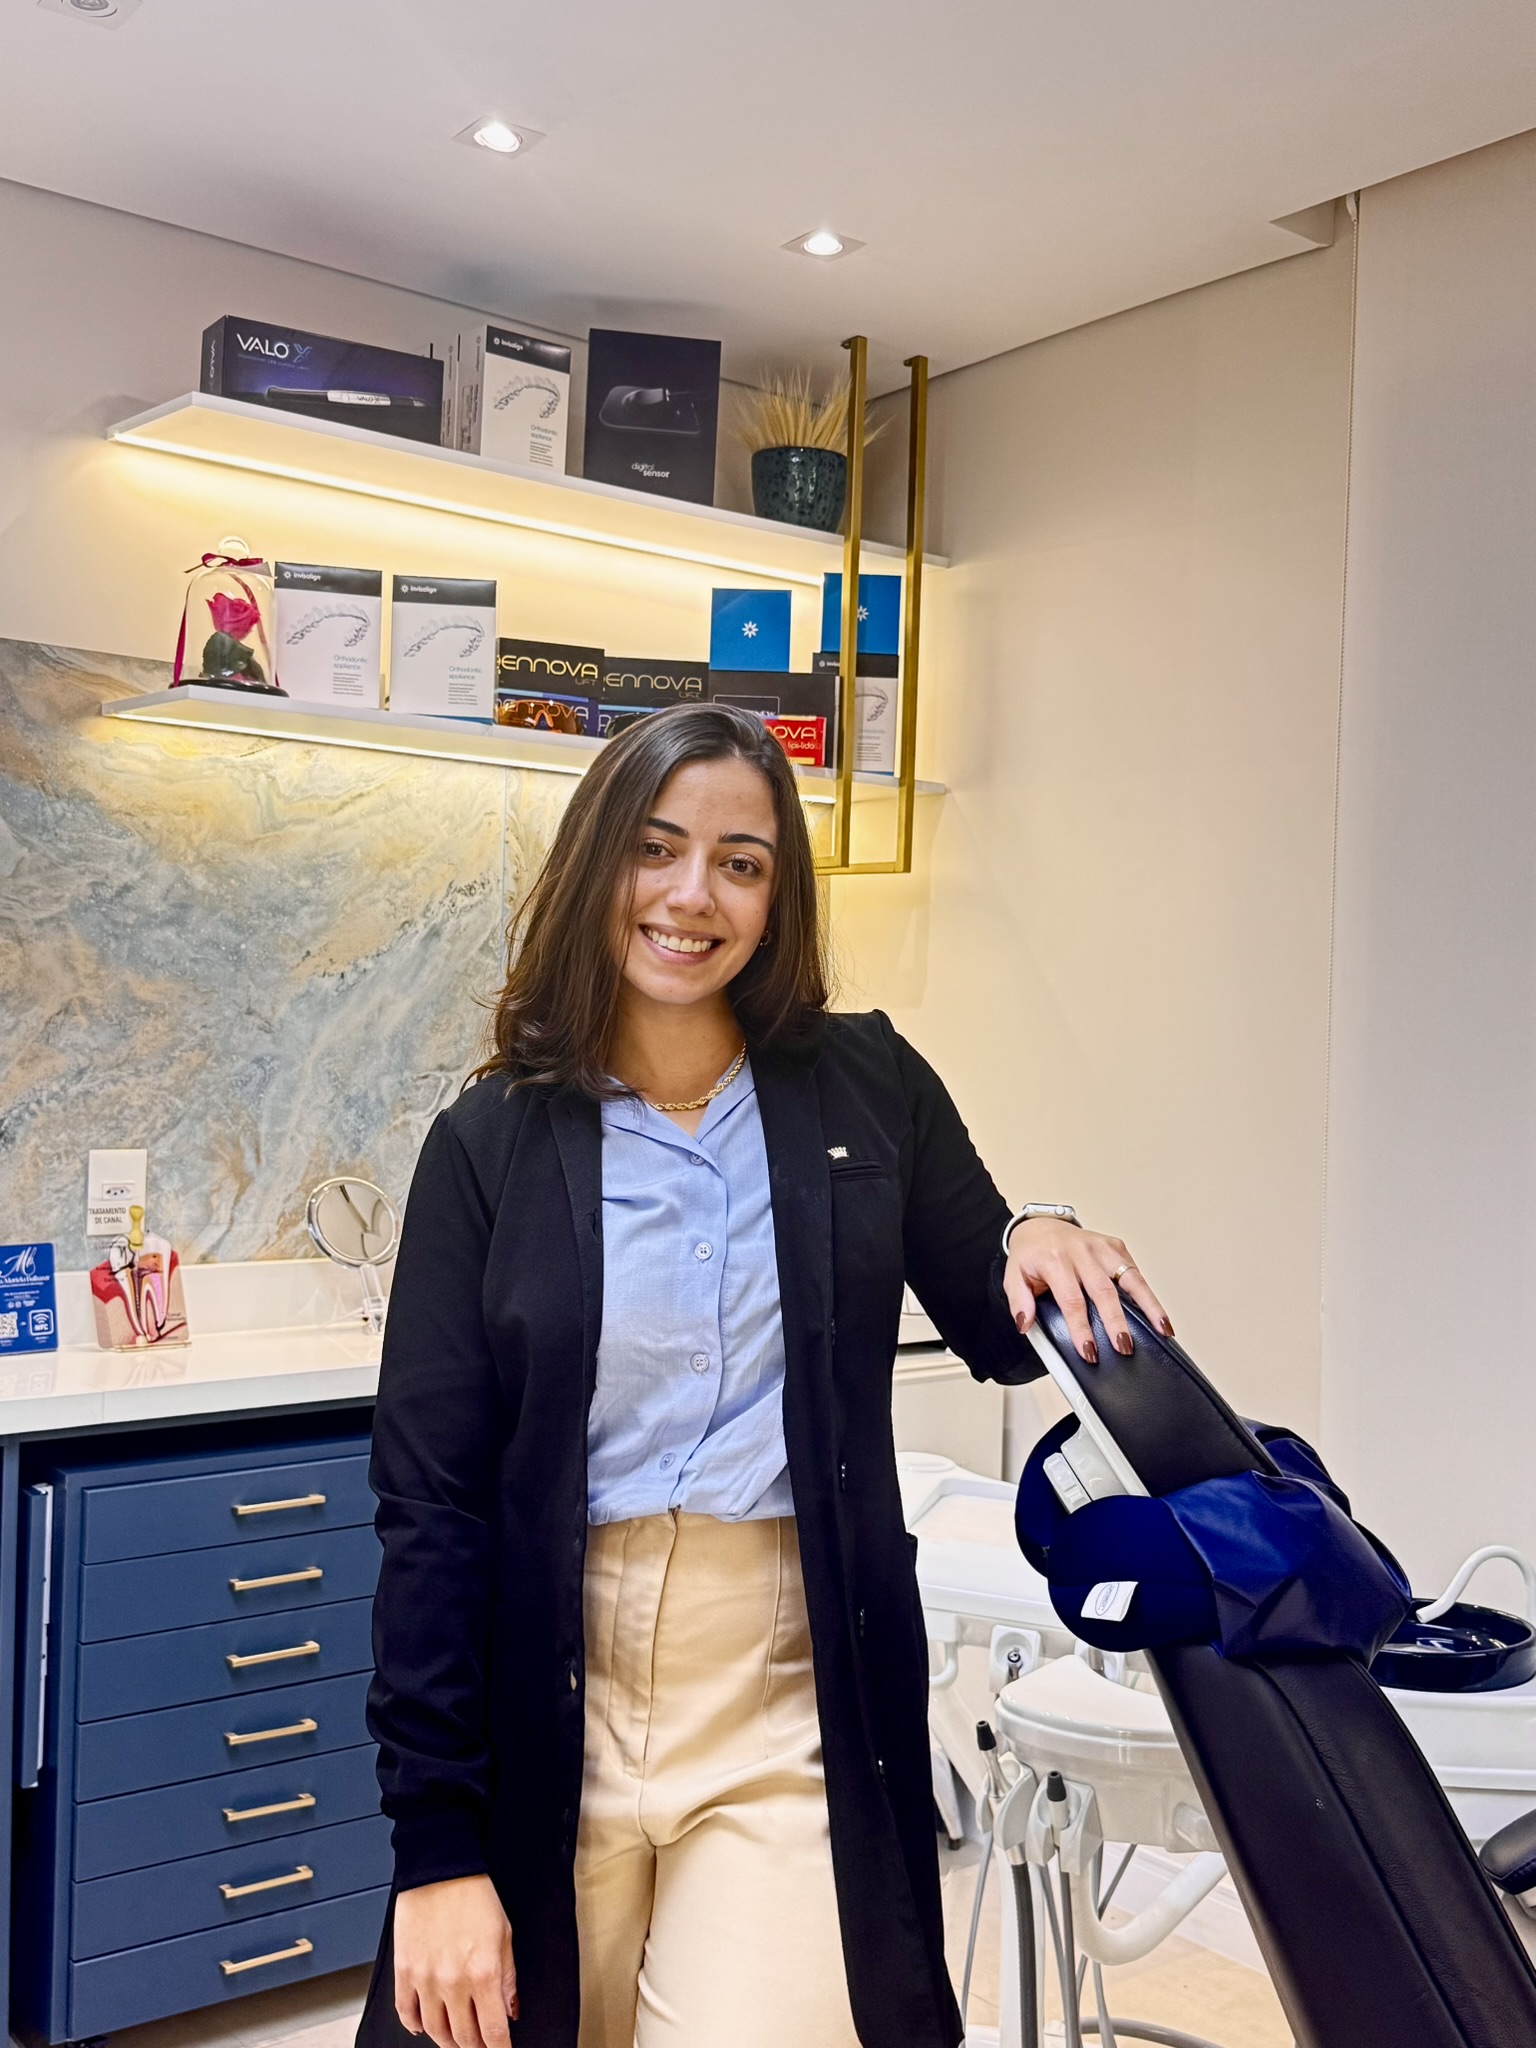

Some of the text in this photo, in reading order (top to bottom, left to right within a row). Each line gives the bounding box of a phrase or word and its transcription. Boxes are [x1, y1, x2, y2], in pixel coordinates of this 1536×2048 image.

[236, 333, 289, 359] VALO
[631, 463, 655, 472] digital
[643, 470, 670, 478] sensor
[293, 571, 322, 582] invisalign
[88, 1207, 127, 1215] TRATAMENTO
[94, 1216, 122, 1225] DE CANAL
[34, 1323, 49, 1332] NFC
